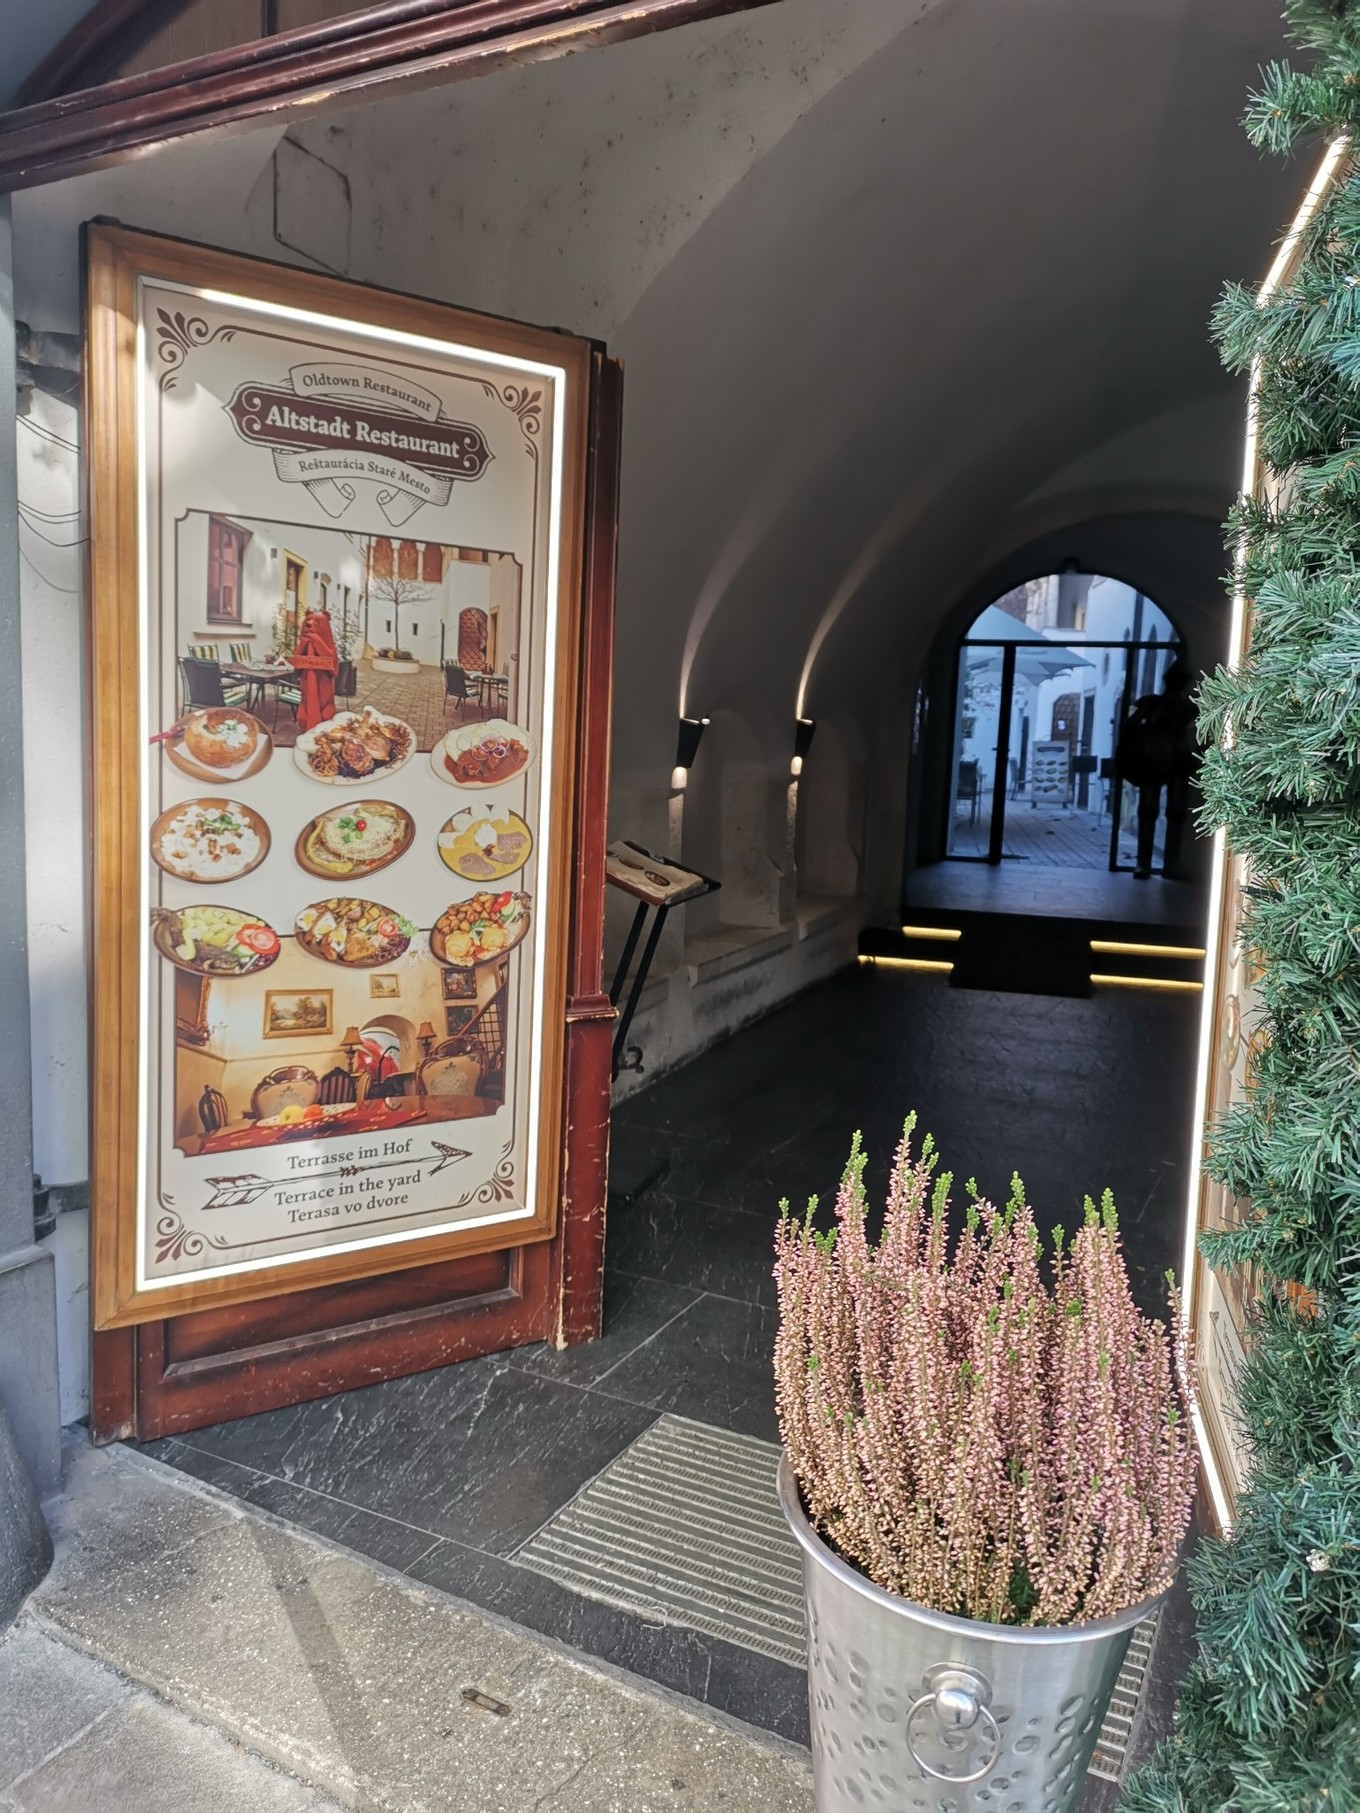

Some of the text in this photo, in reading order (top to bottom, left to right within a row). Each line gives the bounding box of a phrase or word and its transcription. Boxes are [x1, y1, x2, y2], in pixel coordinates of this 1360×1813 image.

[302, 374, 432, 413] Oldtown Restaurant
[265, 405, 460, 459] Altstadt Restaurant
[298, 457, 431, 495] Reštaurácia Staré Mesto
[287, 1139, 413, 1170] Terrasse im Hof
[274, 1170, 422, 1206] Terrace in the yard
[287, 1193, 409, 1224] Terasa vo dvore
